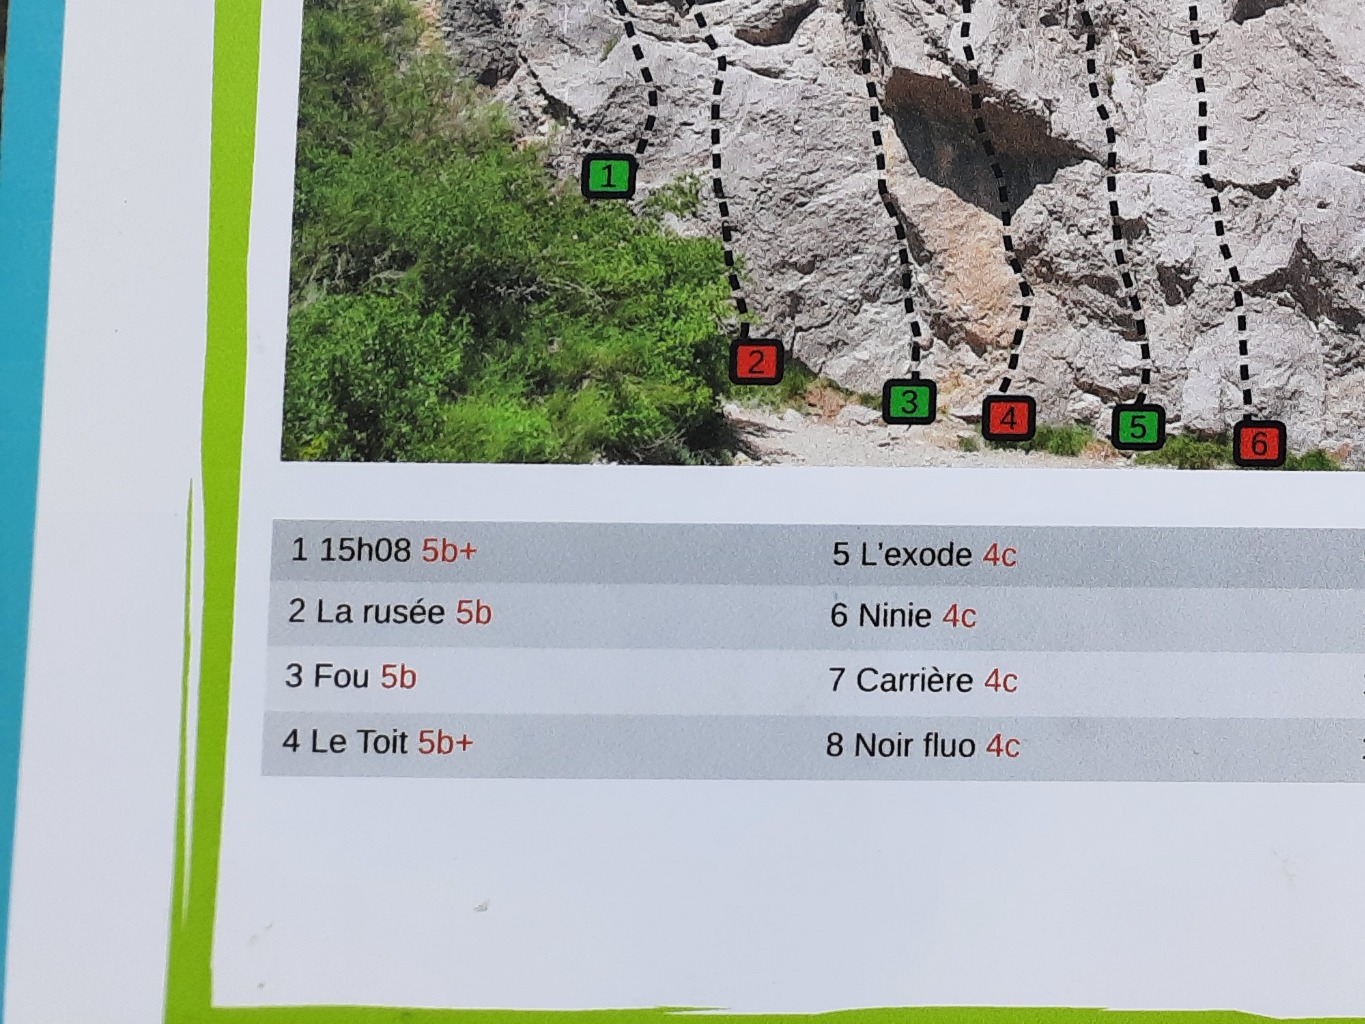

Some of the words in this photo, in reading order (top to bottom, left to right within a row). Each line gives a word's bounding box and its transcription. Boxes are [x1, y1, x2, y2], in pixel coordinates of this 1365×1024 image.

[600, 163, 617, 189] 1
[748, 349, 765, 375] 2
[900, 389, 919, 415] 3
[999, 406, 1018, 430] 4
[1129, 414, 1147, 440] 5
[1251, 431, 1268, 456] 6
[291, 536, 308, 562] 1
[320, 536, 411, 563] 15h08
[422, 537, 478, 563] 5b+
[833, 541, 850, 567] 5
[982, 542, 1017, 567] 4c
[288, 597, 306, 623] 2
[317, 598, 354, 624] La
[363, 597, 446, 625] rusée
[456, 598, 492, 625] 5b
[830, 601, 848, 628] 6
[859, 601, 932, 629] Ninie
[942, 603, 977, 629] 4c
[285, 662, 303, 689] 3
[314, 663, 369, 689] Fou
[381, 662, 417, 690] 5b
[828, 667, 846, 692] 7
[856, 665, 974, 693] Carrière
[984, 667, 1018, 693] 4c
[281, 728, 301, 753] 4
[311, 728, 347, 754] Le
[355, 729, 409, 755] Toit
[418, 728, 474, 755] 5b+
[826, 731, 844, 758] 8
[854, 732, 914, 758] Noir
[922, 731, 976, 758] fluo
[985, 733, 1021, 758] 4c
